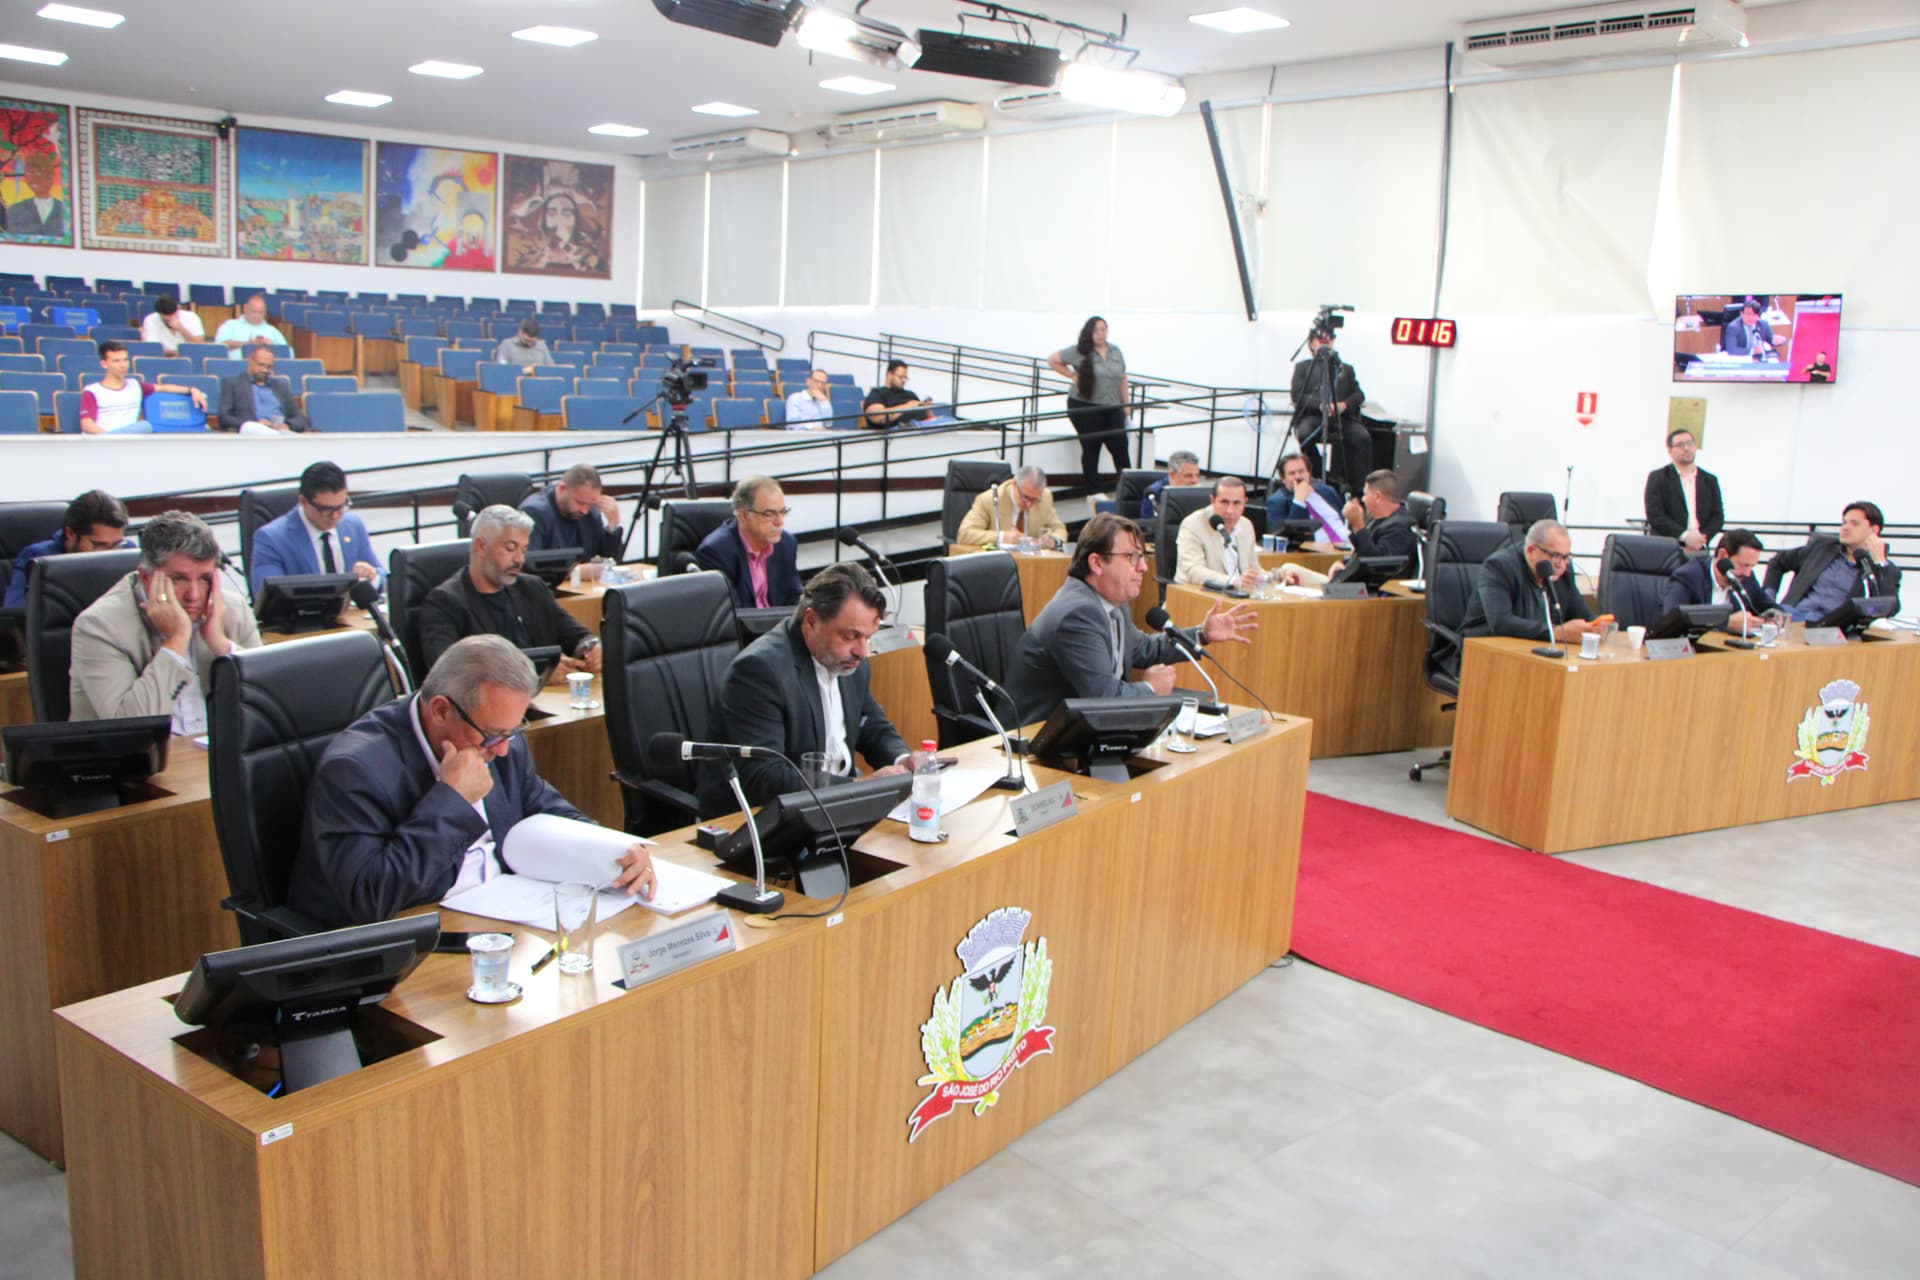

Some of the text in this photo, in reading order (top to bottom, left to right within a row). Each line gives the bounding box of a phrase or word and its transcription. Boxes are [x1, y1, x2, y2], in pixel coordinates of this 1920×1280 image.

[695, 929, 711, 942] Silva
[942, 1082, 960, 1097] SÃO
[959, 1083, 979, 1097] JOSÉ
[979, 1081, 990, 1095] DO
[1002, 1039, 1028, 1074] PRETO
